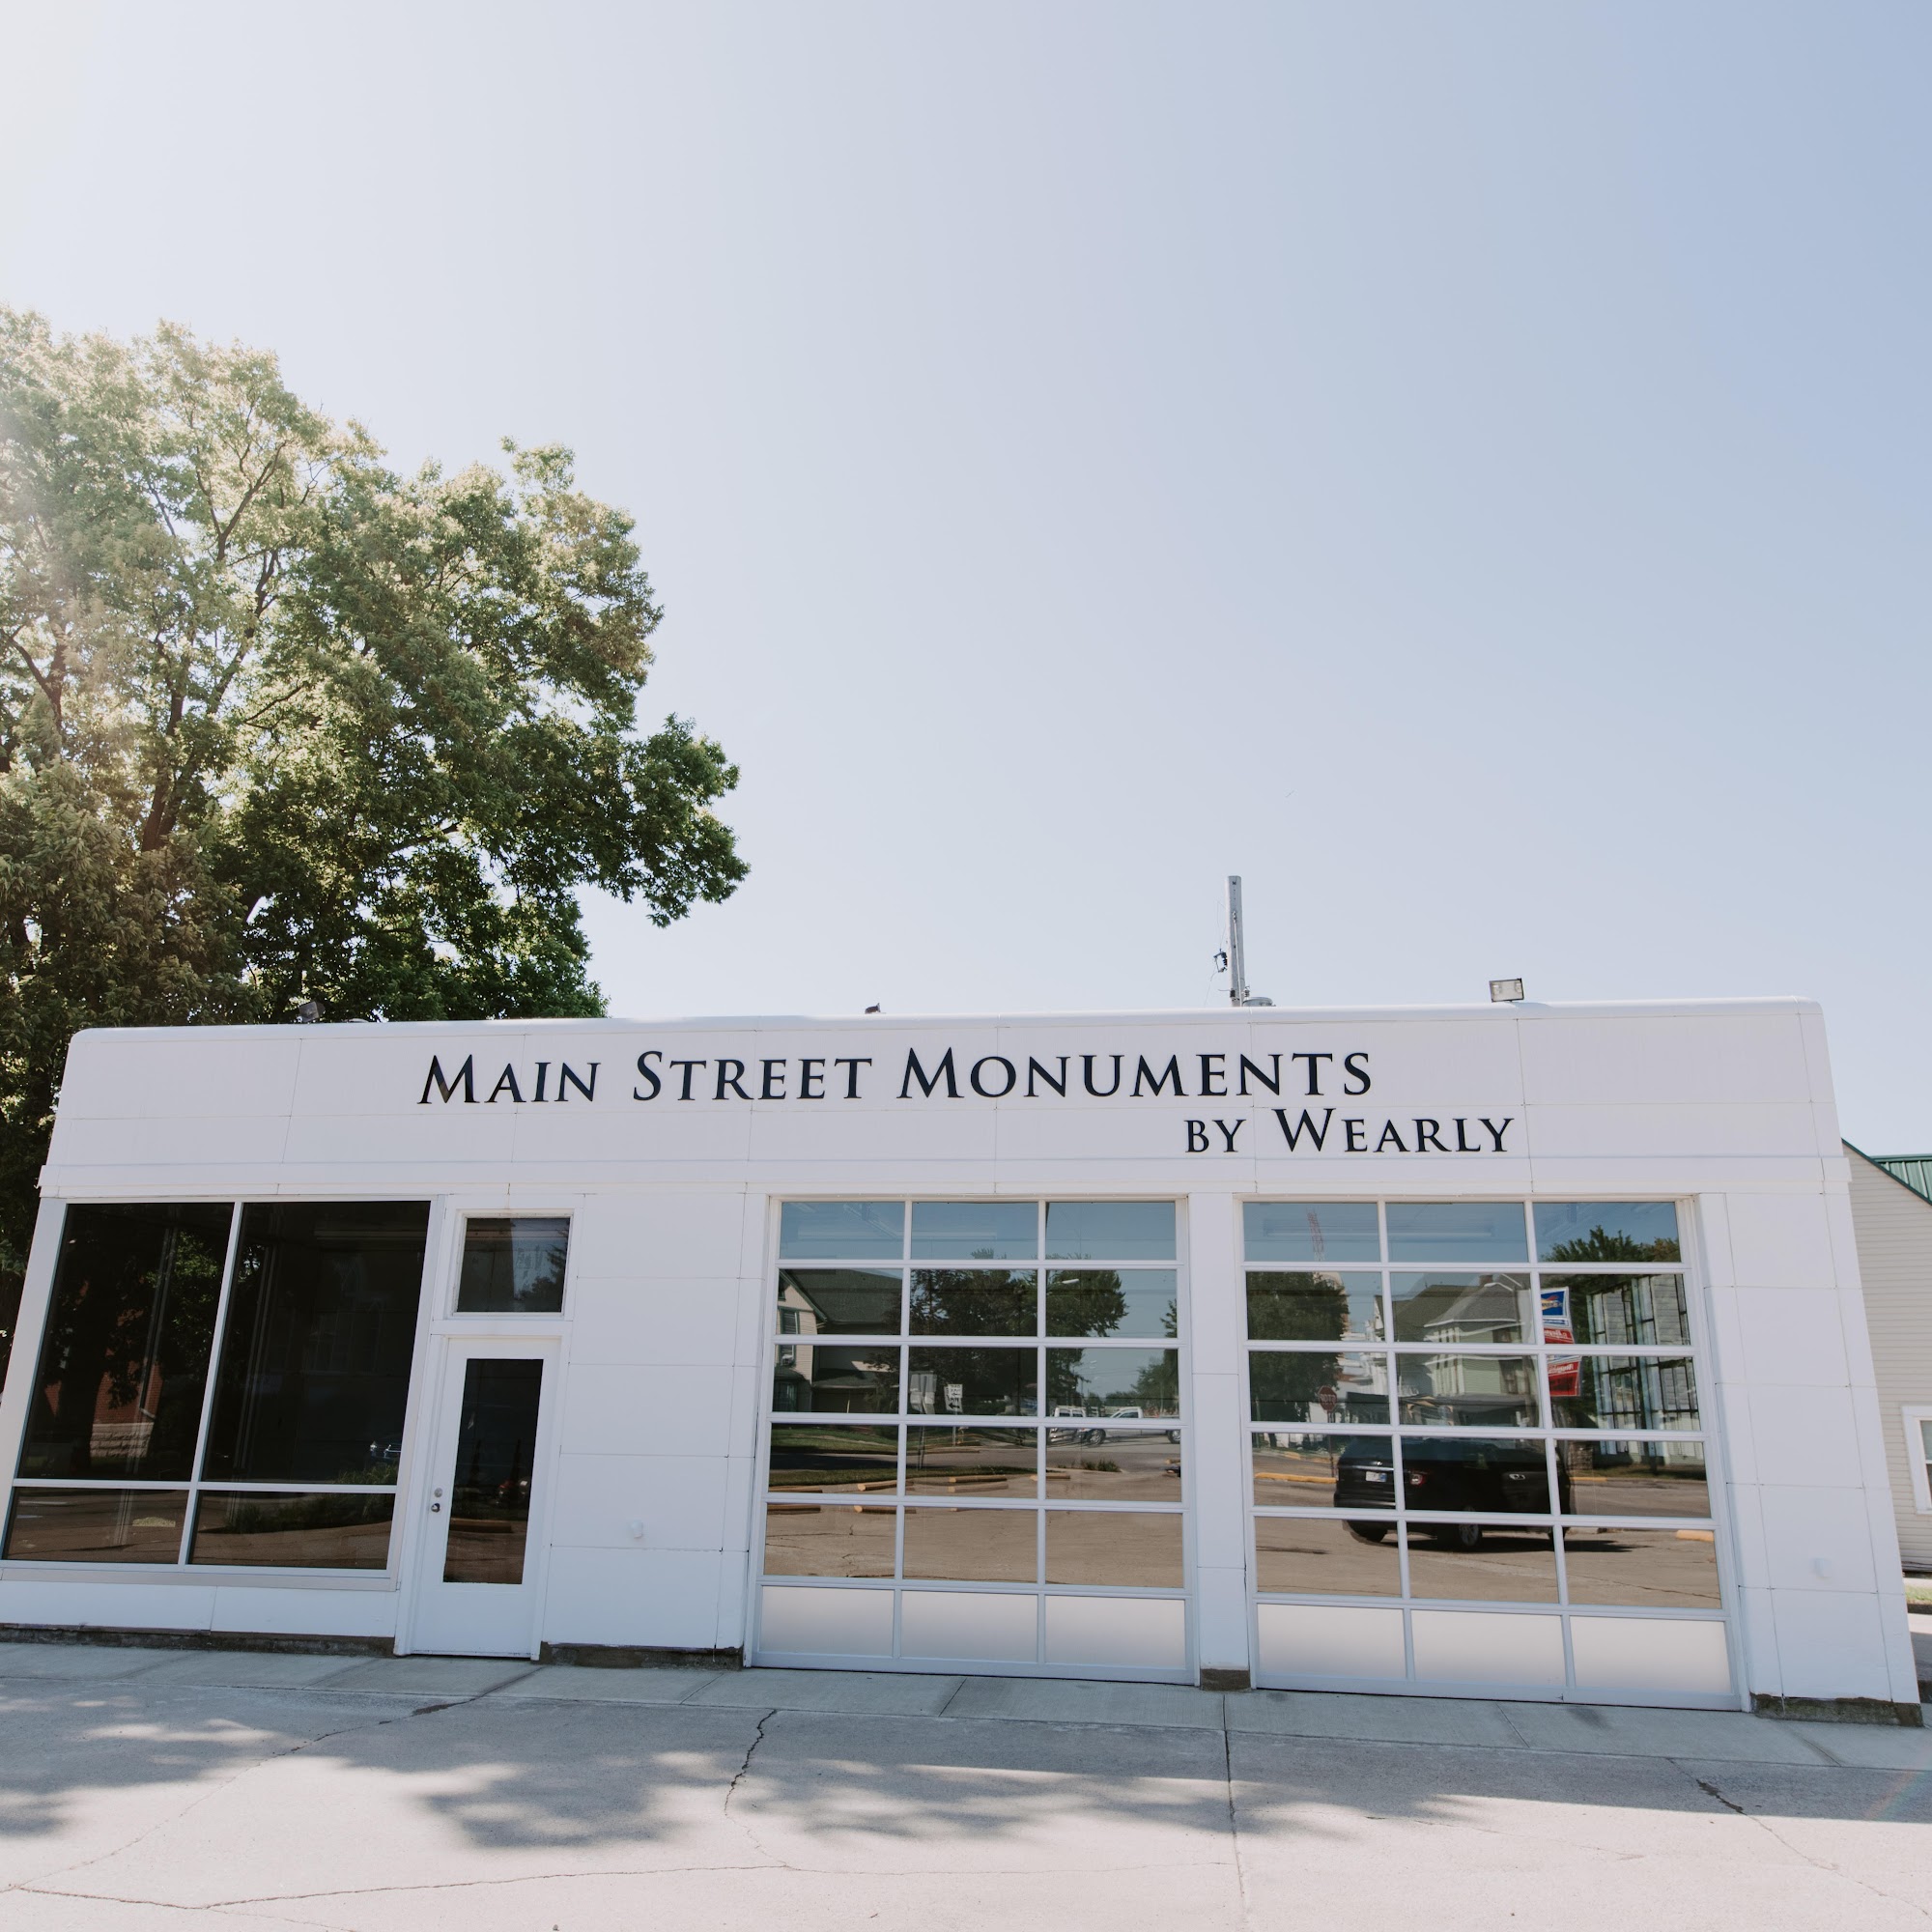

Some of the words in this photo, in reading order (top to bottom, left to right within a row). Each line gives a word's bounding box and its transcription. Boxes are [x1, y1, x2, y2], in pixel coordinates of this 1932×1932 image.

[417, 1054, 601, 1105] MAIN
[633, 1050, 872, 1101] STREET
[896, 1046, 1372, 1099] MONUMENTS
[1184, 1119, 1247, 1153] BY
[1271, 1108, 1515, 1153] WEARLY
